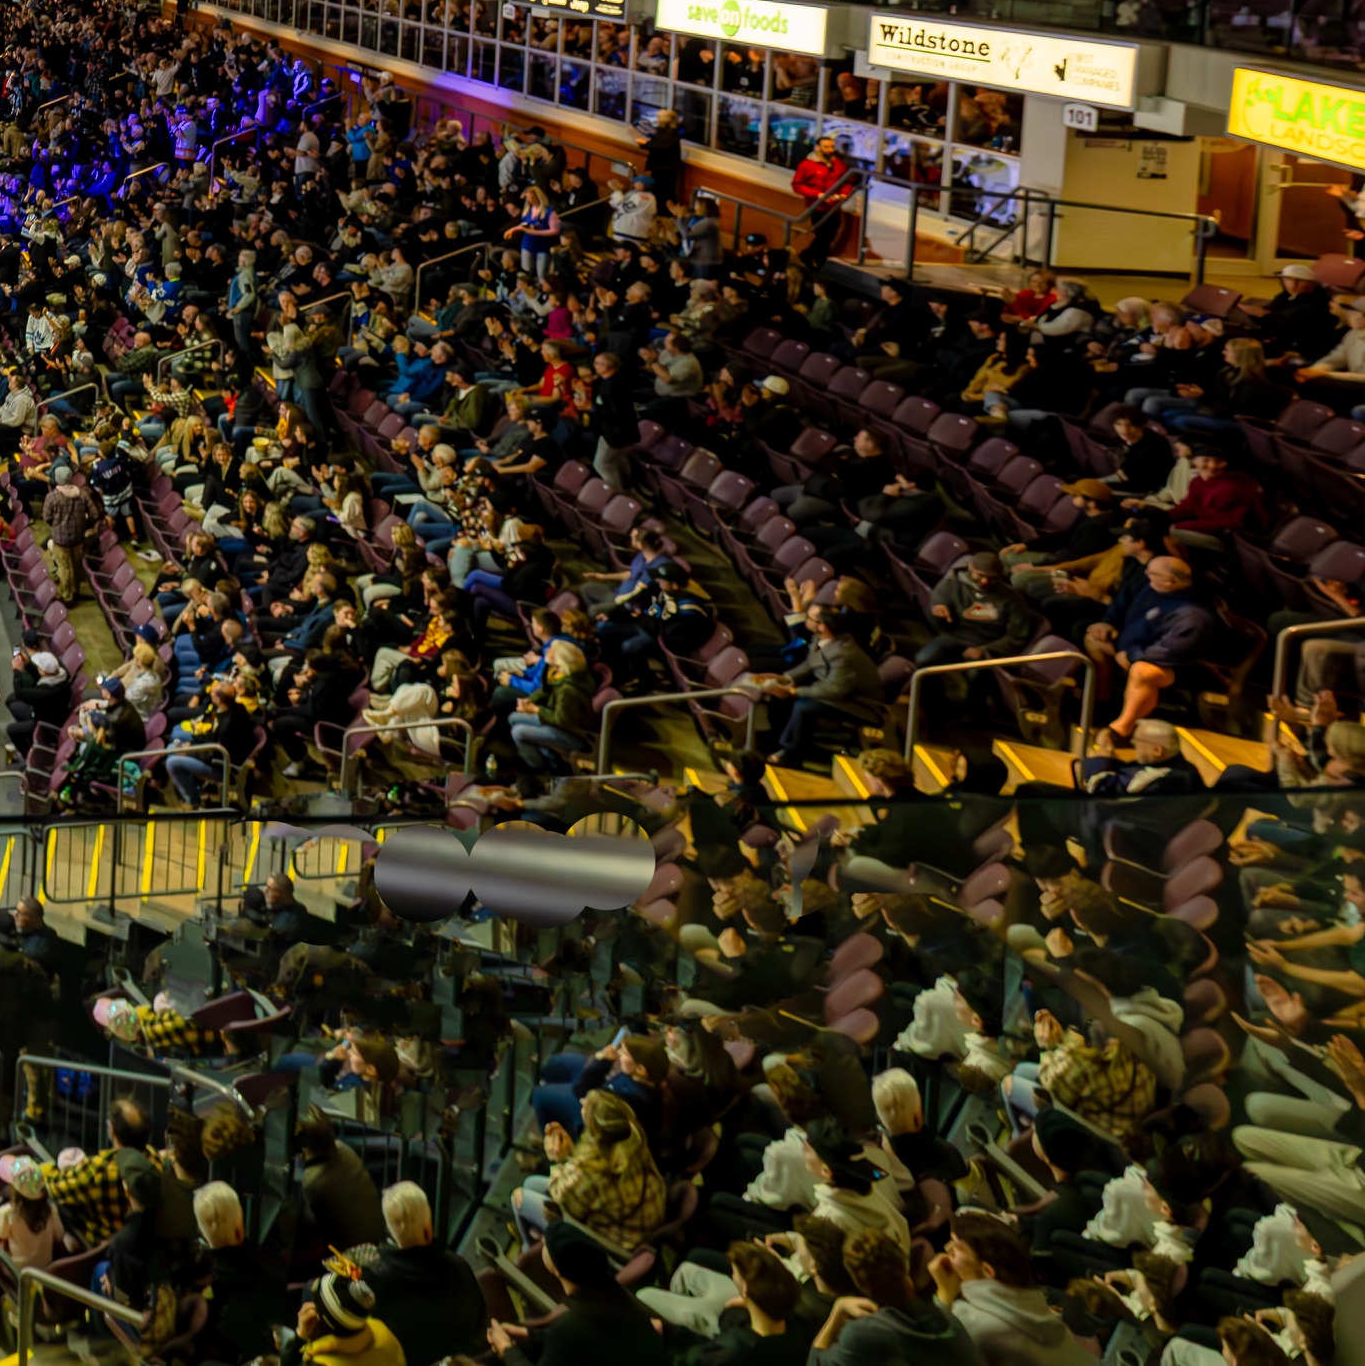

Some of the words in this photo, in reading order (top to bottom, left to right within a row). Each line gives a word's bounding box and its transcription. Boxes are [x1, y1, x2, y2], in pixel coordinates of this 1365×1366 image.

[688, 5, 717, 23] save
[721, 10, 740, 26] on
[744, 6, 788, 34] foods
[880, 24, 990, 56] Wildstone
[886, 51, 945, 69] CONSTRUCTION
[949, 61, 977, 73] GROUP
[1074, 53, 1094, 64] BEST
[1074, 64, 1116, 79] MANAGED
[1073, 76, 1119, 91] COMPANIES
[1068, 110, 1092, 126] 101
